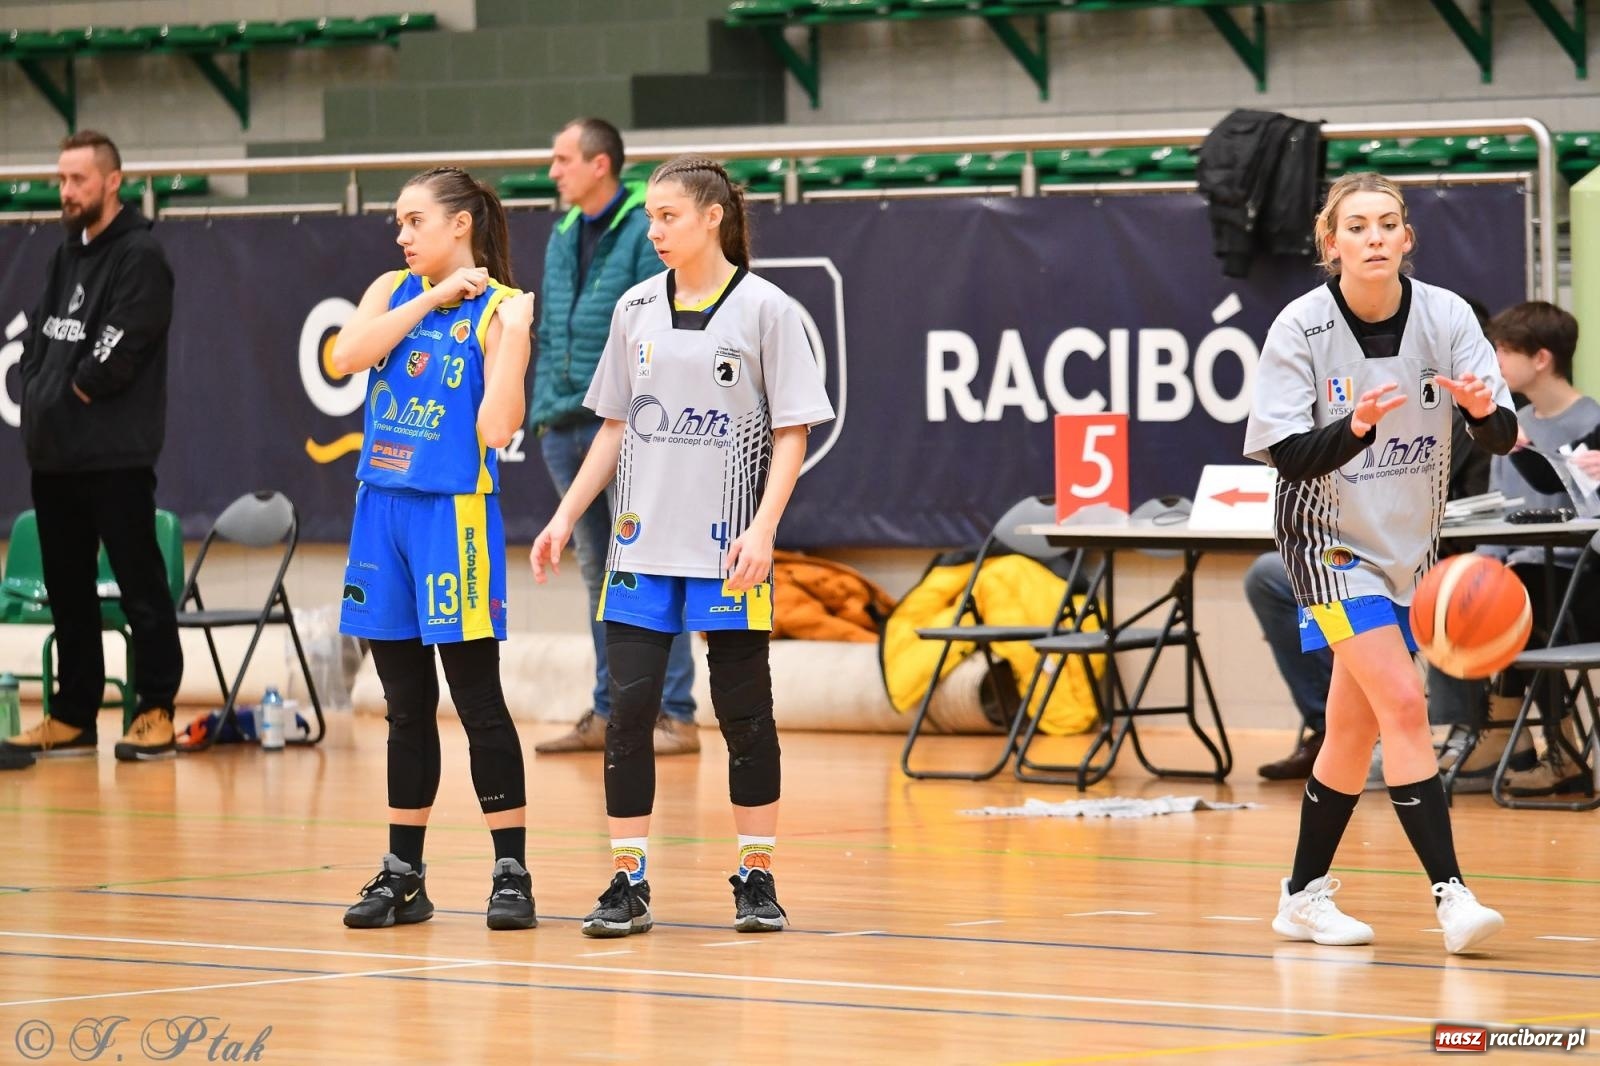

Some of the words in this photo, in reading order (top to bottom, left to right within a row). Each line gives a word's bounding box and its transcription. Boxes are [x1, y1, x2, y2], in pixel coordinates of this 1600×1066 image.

[1304, 319, 1335, 337] COLO
[440, 355, 465, 388] 13
[398, 396, 446, 430] hlt
[672, 407, 730, 437] hlt
[668, 437, 701, 447] concept
[713, 440, 732, 449] light
[1378, 435, 1437, 468] hlt
[1070, 424, 1116, 499] 5
[1359, 473, 1375, 481] new
[1375, 466, 1408, 478] concept
[1410, 466, 1421, 475] of
[1421, 463, 1436, 474] light
[711, 521, 728, 550] 4
[465, 527, 478, 609] BASKET
[425, 572, 459, 617] 13
[709, 605, 743, 613] COLO
[427, 617, 459, 625] COLO
